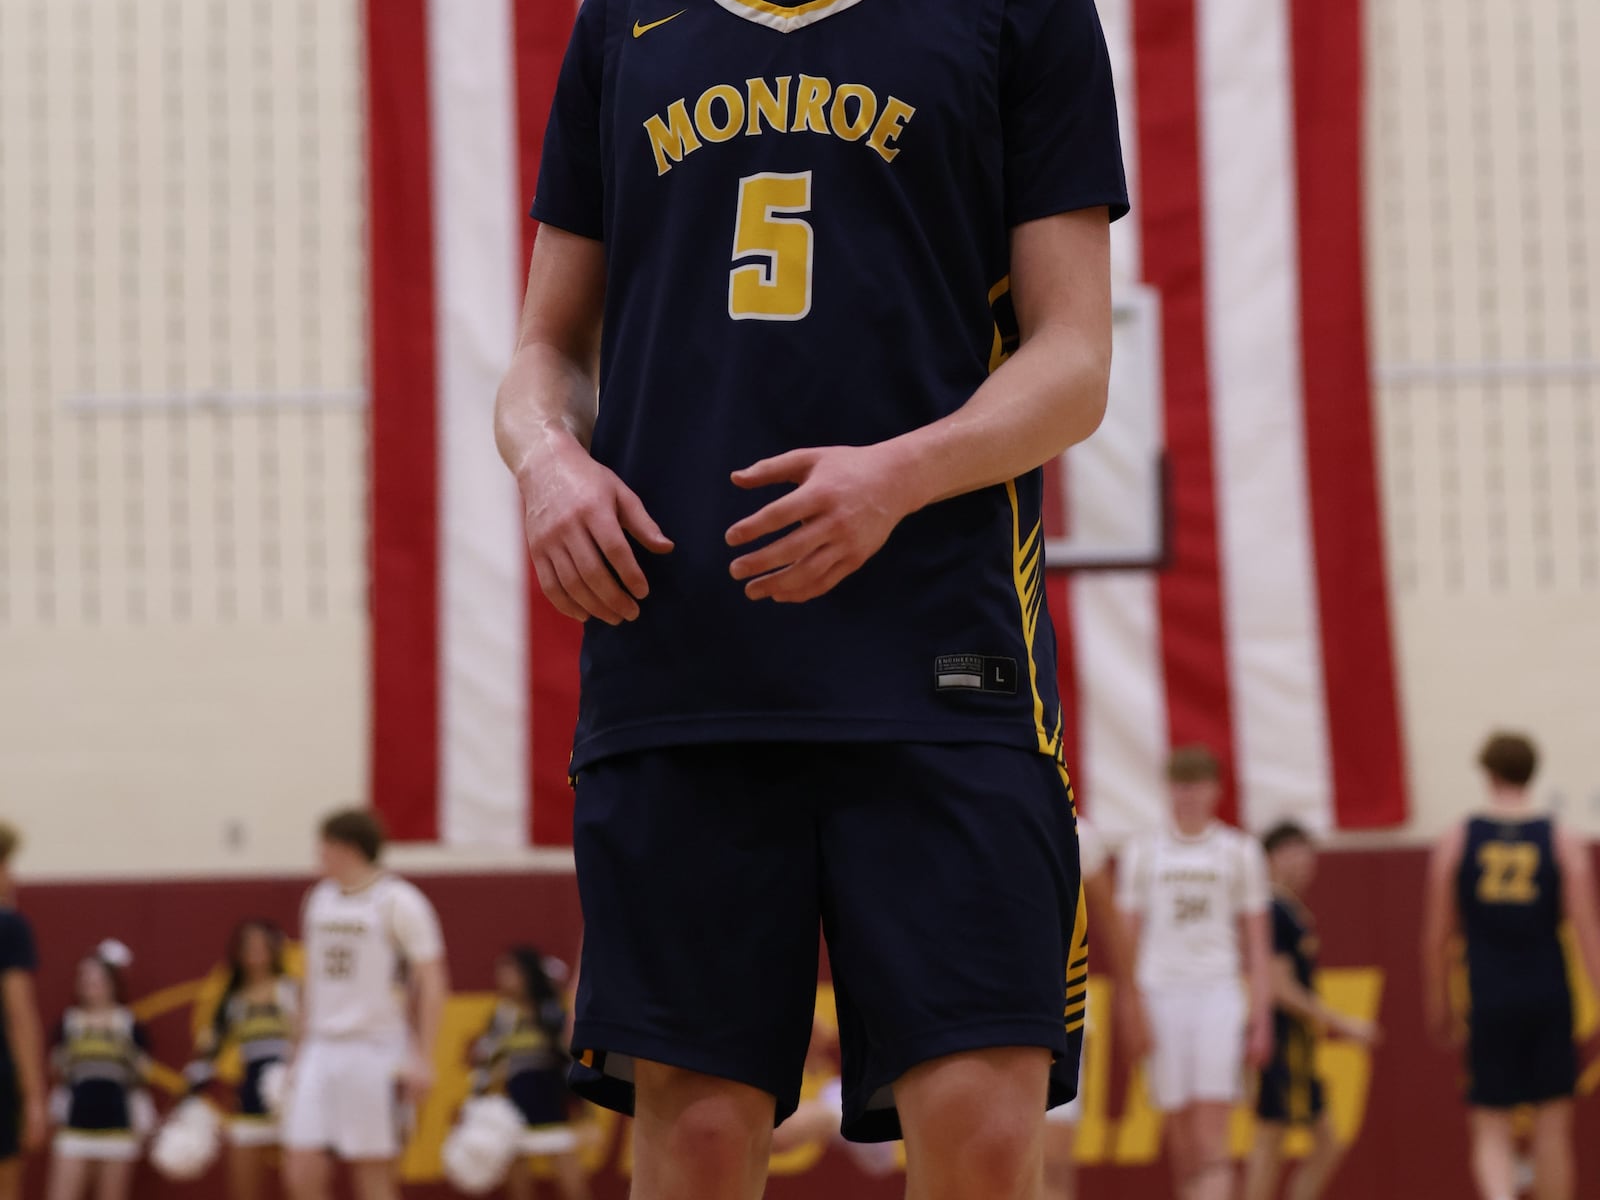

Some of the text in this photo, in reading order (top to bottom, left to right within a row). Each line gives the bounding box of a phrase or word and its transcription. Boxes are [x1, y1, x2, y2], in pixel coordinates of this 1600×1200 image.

[643, 74, 916, 176] MONROE
[728, 170, 814, 321] 5
[995, 666, 1005, 682] L
[1478, 842, 1540, 903] 22
